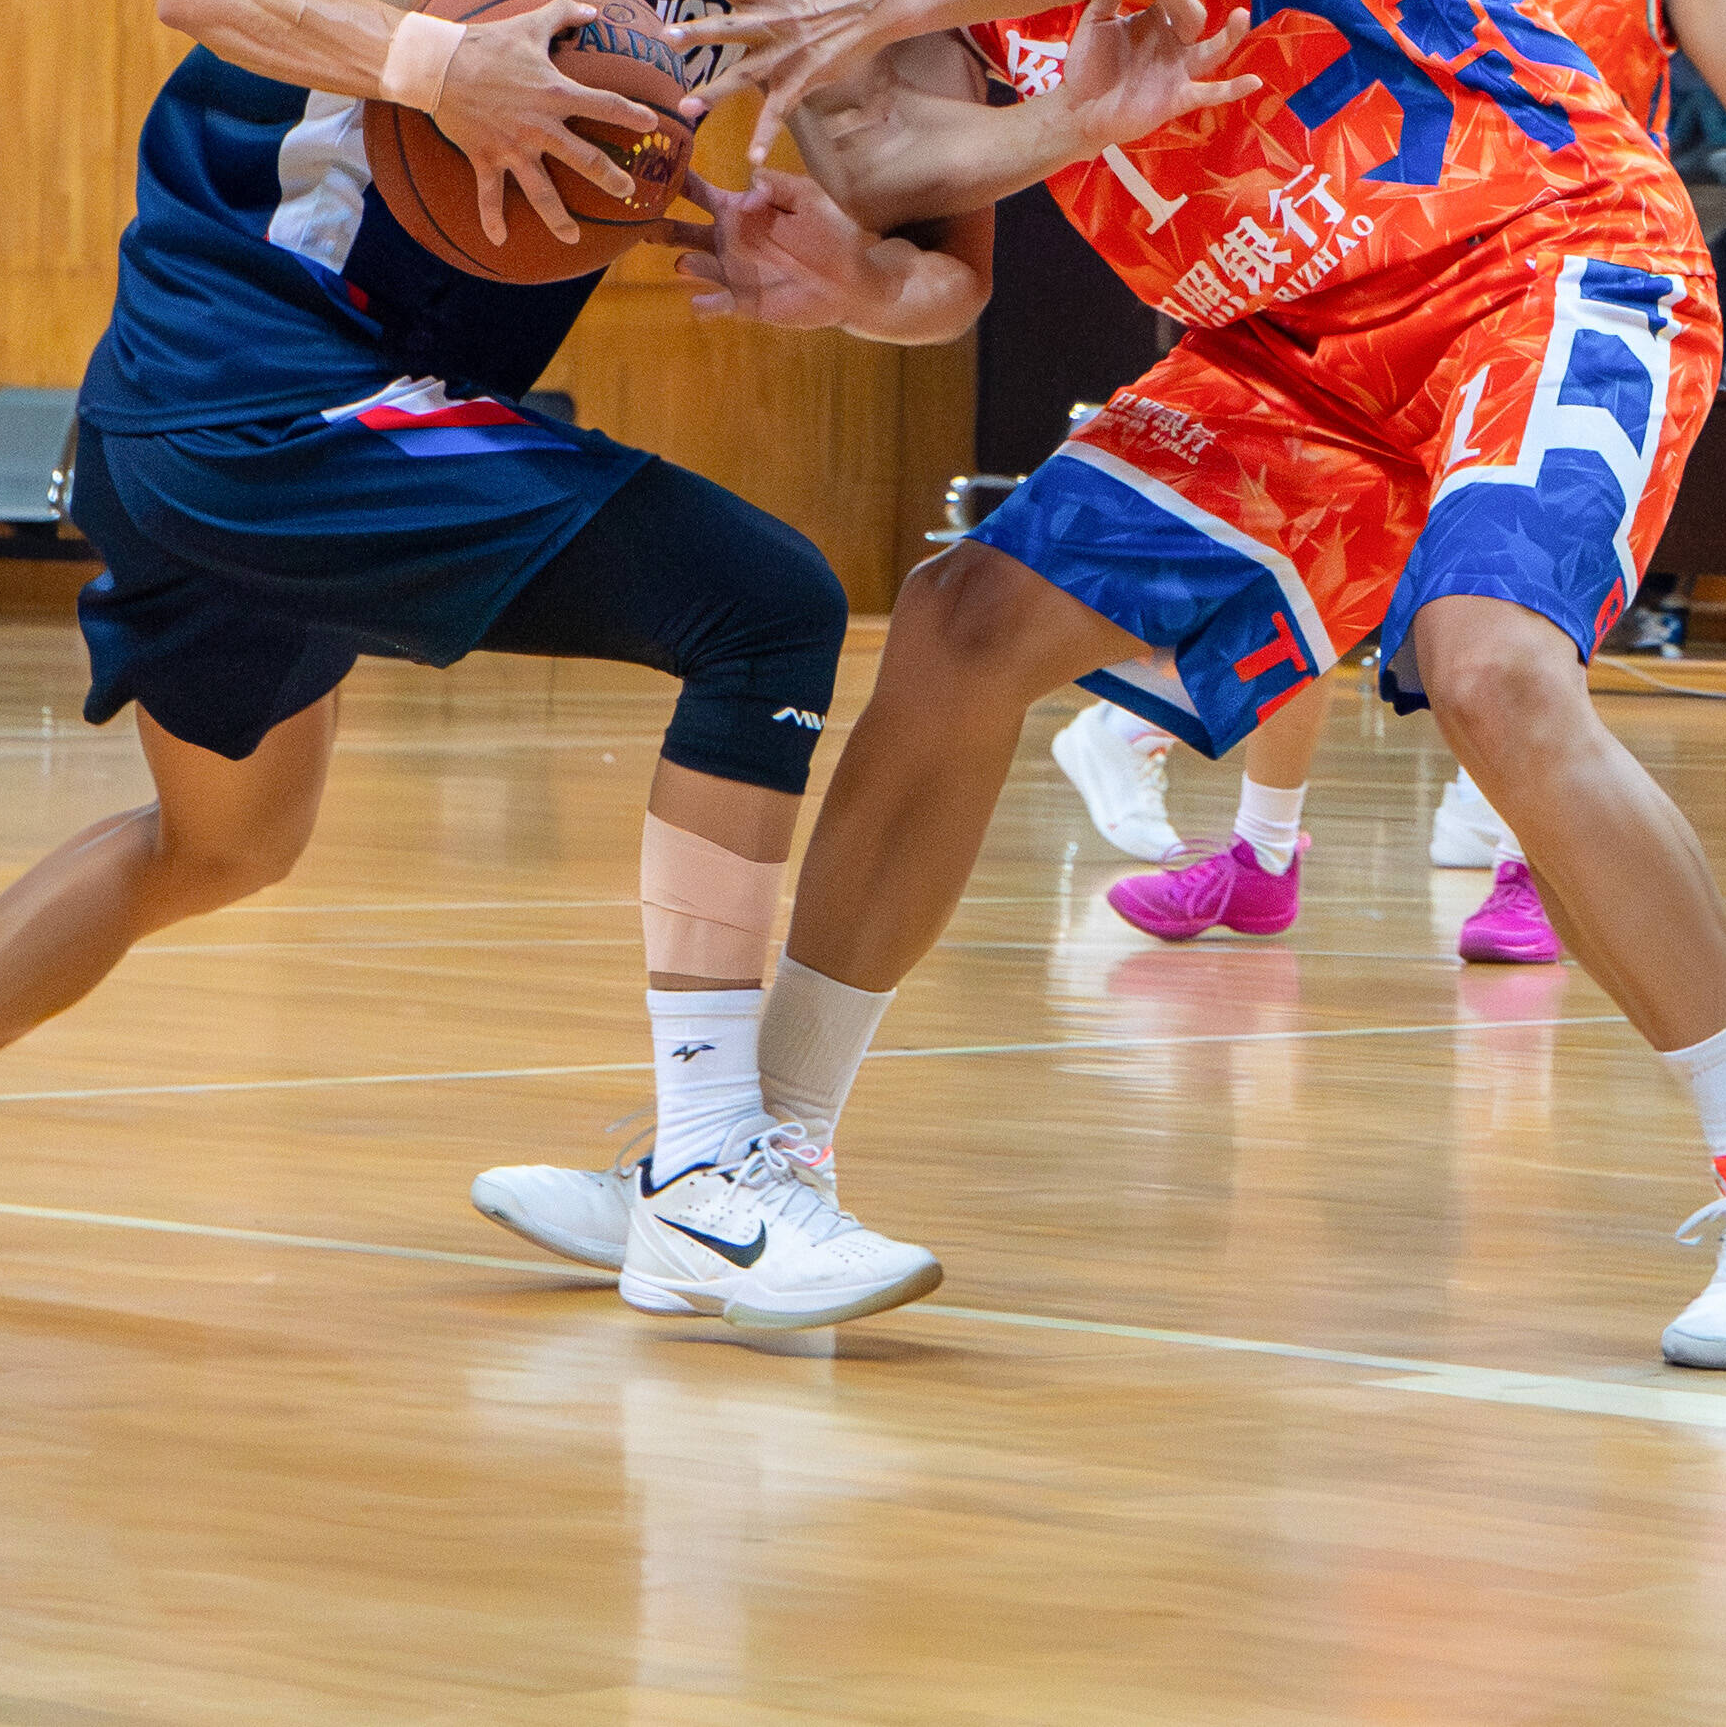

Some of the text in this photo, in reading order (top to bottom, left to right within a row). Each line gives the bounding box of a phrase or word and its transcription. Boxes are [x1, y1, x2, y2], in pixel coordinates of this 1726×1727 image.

[1006, 30, 1070, 100] 金
[1101, 143, 1189, 236] 1
[1273, 214, 1375, 304] RIZHAO
[1443, 364, 1491, 474] 1
